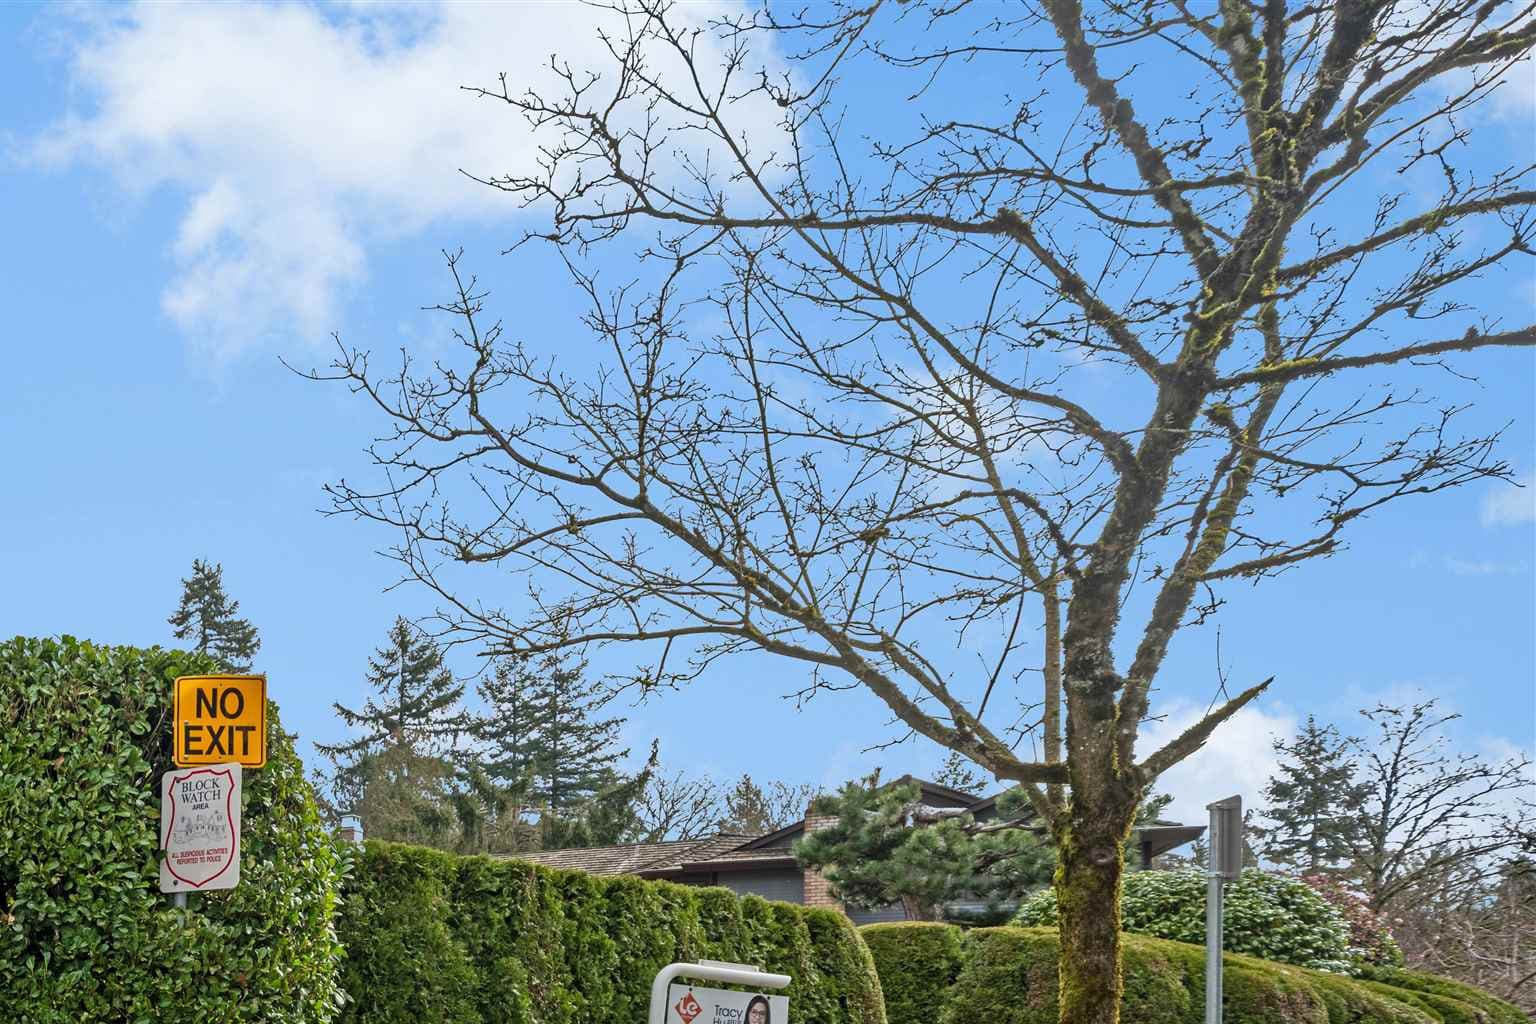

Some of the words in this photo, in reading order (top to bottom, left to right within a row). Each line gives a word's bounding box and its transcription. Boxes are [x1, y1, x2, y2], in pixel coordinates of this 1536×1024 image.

[195, 687, 244, 719] NO
[184, 725, 256, 756] EXIT
[182, 778, 220, 792] BLOCK
[181, 789, 221, 804] WATCH
[714, 1004, 743, 1020] Tracy
